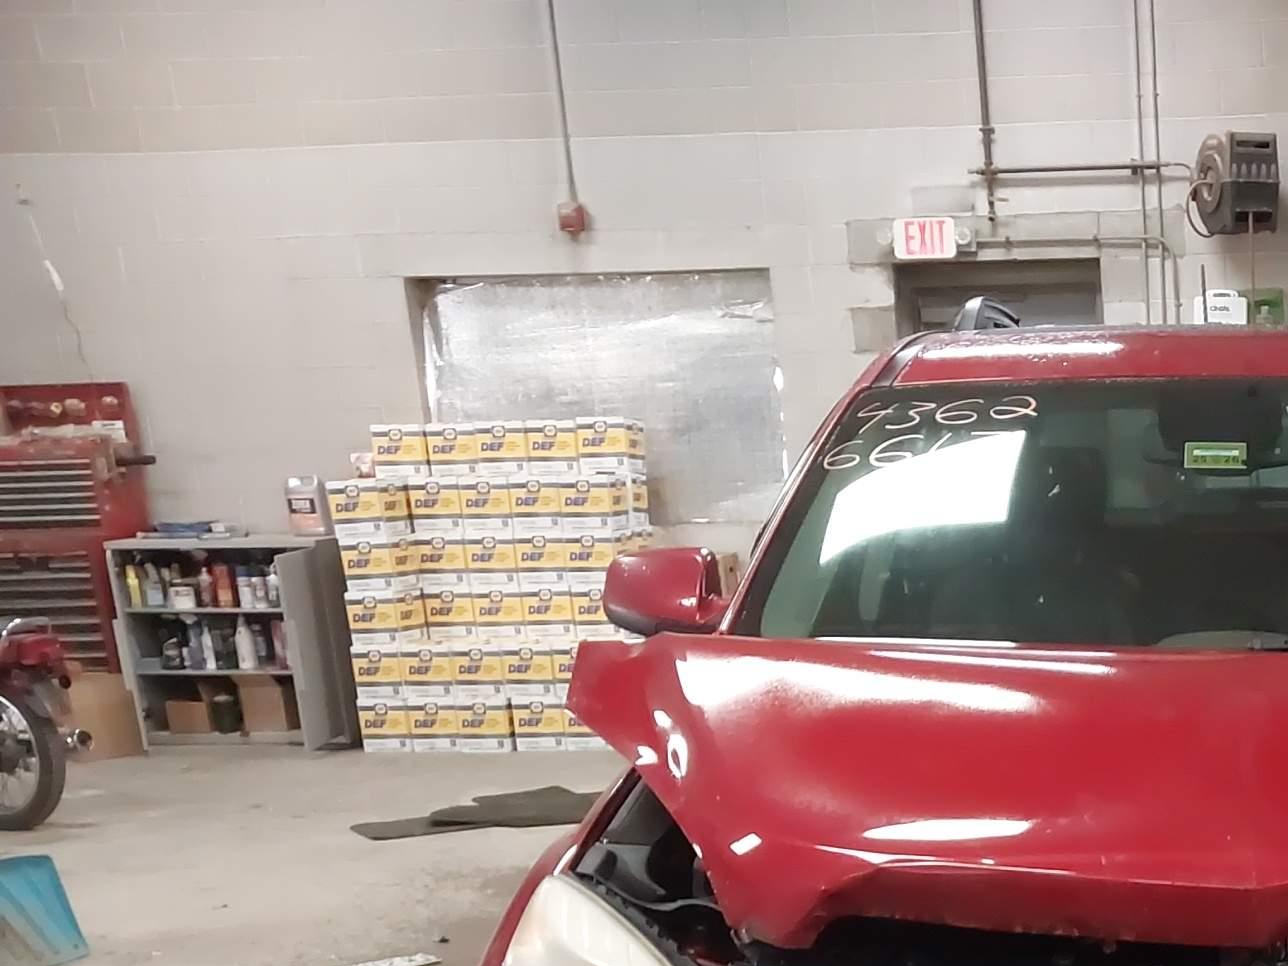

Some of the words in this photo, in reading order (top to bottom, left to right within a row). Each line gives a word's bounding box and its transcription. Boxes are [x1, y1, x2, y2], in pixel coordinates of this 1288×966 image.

[904, 220, 946, 255] EXIT
[857, 396, 1038, 434] 4362
[481, 442, 504, 452] DEF
[532, 441, 555, 451] DEF
[582, 437, 605, 447] DEF
[377, 445, 400, 455] DEF
[432, 444, 456, 454] DEF
[415, 499, 438, 508] DEF
[466, 499, 489, 508] DEF
[516, 497, 539, 506] DEF
[565, 497, 588, 506] DEF
[335, 502, 359, 513] DEF
[421, 553, 443, 563] DEF
[471, 553, 494, 562] DEF
[521, 552, 544, 561] DEF
[570, 552, 593, 561] DEF
[348, 558, 370, 569] DEF
[430, 607, 453, 616] DEF
[479, 606, 501, 616] DEF
[528, 605, 551, 615] DEF
[578, 605, 601, 615] DEF
[352, 613, 375, 623] DEF
[358, 666, 380, 676] DEF
[408, 665, 432, 675] DEF
[459, 665, 482, 674] DEF
[508, 664, 531, 673] DEF
[365, 719, 387, 728] DEF
[414, 719, 437, 728] DEF
[462, 719, 485, 728] DEF
[519, 718, 542, 727] DEF
